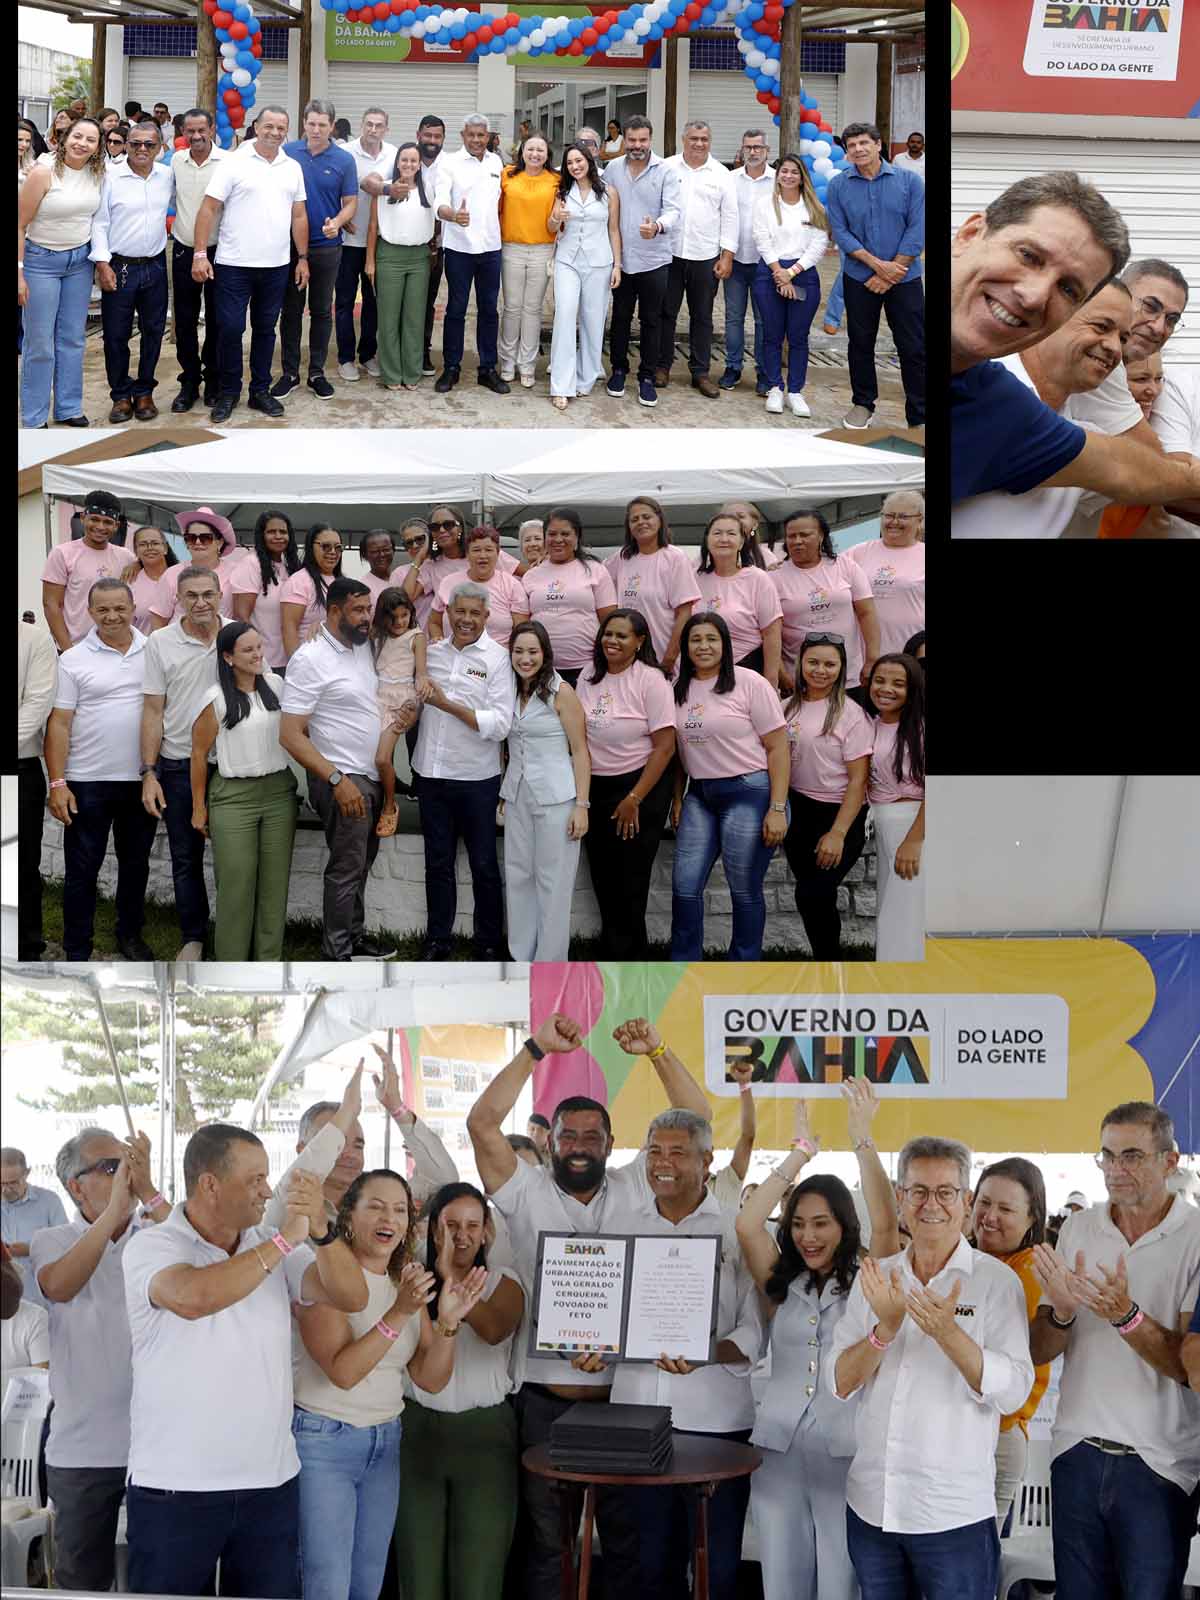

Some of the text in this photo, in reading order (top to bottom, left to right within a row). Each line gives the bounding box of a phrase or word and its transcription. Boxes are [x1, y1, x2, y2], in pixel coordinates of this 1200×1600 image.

[1043, 4, 1171, 32] BAHIA
[336, 26, 352, 36] DA
[1046, 61, 1154, 73] DO LADO DA GENTE
[810, 603, 831, 612] SCFV
[724, 1008, 930, 1032] GOVERNO DA
[958, 1030, 1044, 1044] DO LADO
[724, 1036, 930, 1084] BAHIA
[958, 1049, 1047, 1064] DA GENTE
[564, 1244, 606, 1255] BAHIA
[546, 1259, 614, 1268] PAVIMENTAÇÃO
[545, 1270, 608, 1278] URBANIZAÇÃO
[556, 1290, 608, 1299] CERQUEIRA,
[553, 1300, 595, 1308] POVOADO
[558, 1330, 600, 1340] ITIRUÇU
